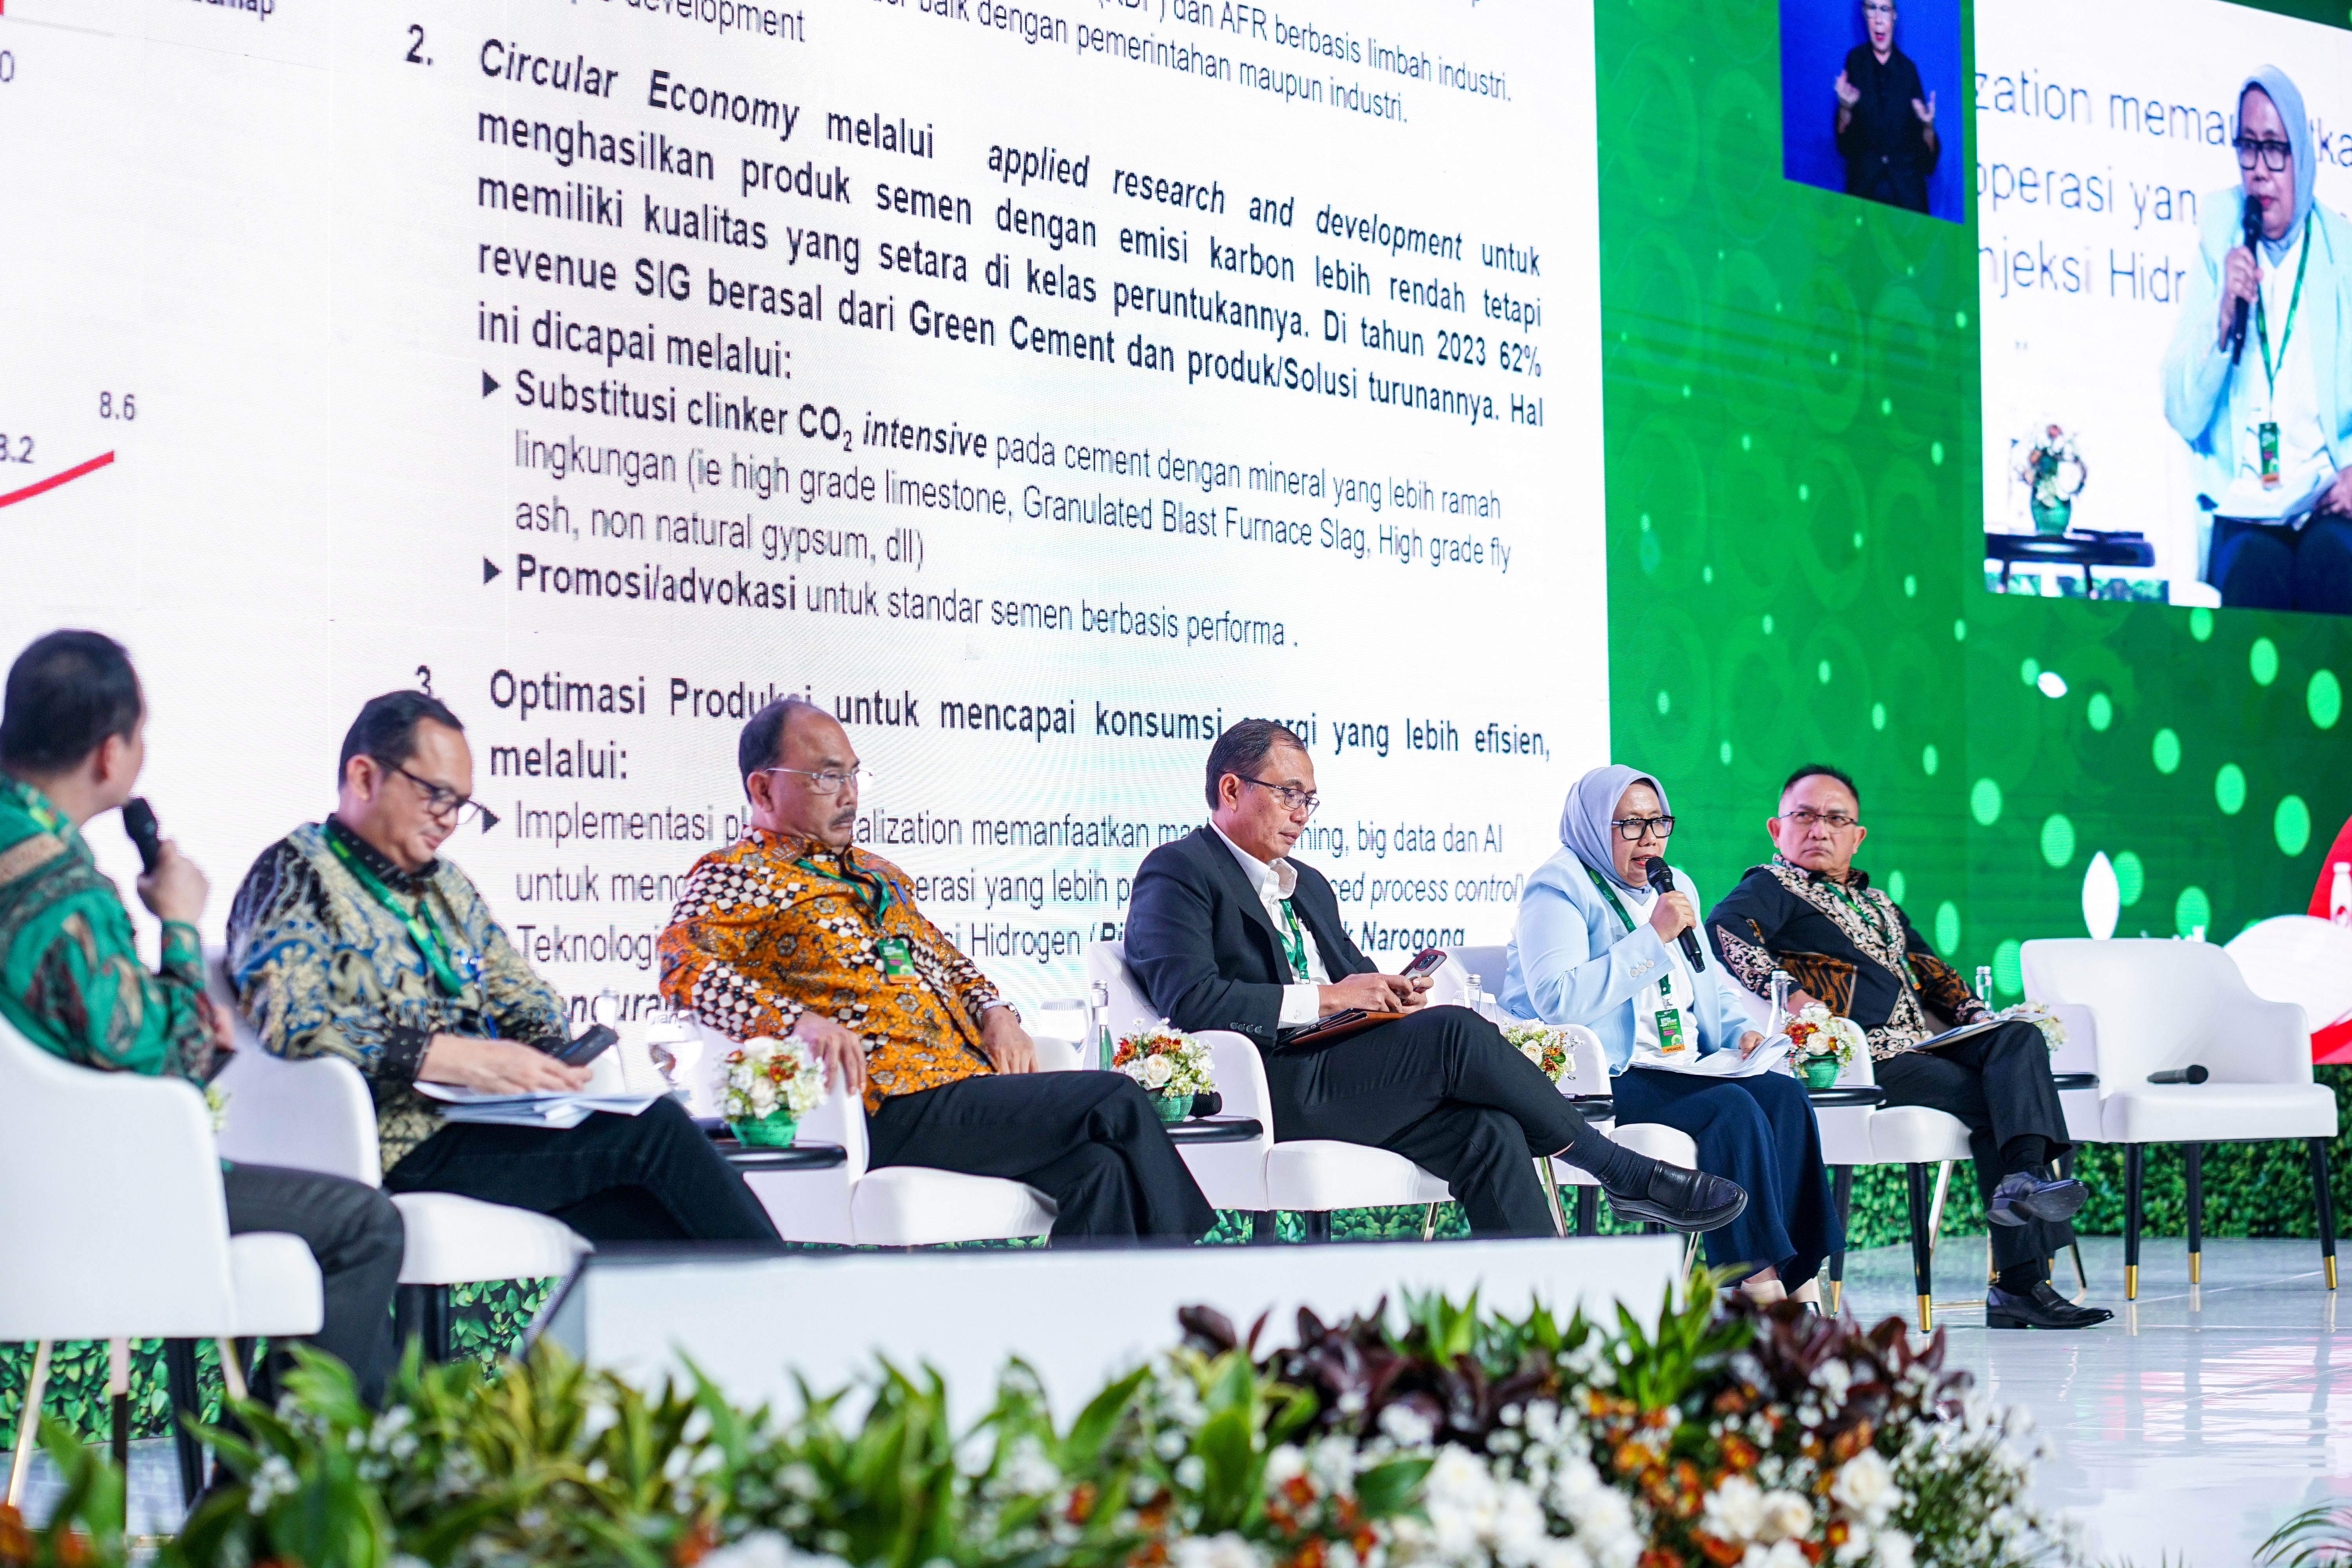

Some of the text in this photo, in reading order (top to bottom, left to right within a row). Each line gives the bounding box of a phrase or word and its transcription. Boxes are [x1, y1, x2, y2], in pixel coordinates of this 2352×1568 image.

[404, 24, 434, 66] 2.
[627, 0, 805, 42] velopment
[978, 0, 1068, 45] dengan
[1076, 23, 1232, 82] pemerintahan
[1240, 61, 1323, 103] maupun
[1330, 76, 1408, 123] industri.
[1220, 0, 1268, 42] AFR
[1275, 13, 1362, 64] berbasis
[1367, 36, 1431, 82] limbah
[1438, 55, 1512, 102] industri.
[479, 37, 1541, 276] Circular Economy melalui applied research and development untuk
[477, 111, 1541, 334] menghasilkan produk semen dengan emisi karbon lebih rendah tetapi
[2130, 181, 2198, 230] yan
[477, 176, 1542, 378] memiliki kualitas yang setara di kelas peruntukannya. Di tahun 2023 62%
[2111, 248, 2186, 304] Hidr
[478, 242, 1544, 426] revenue SIG berasal dari Green Cement dan produk/Solusi turunannya. Hal
[478, 299, 792, 381] ini dicapai melalui:
[99, 391, 136, 421] 8.6
[514, 367, 677, 424] Substitusi
[687, 390, 789, 436] clinker
[862, 411, 989, 460] intensive
[997, 431, 1055, 470] pada
[1065, 443, 1151, 478] cement
[1159, 448, 1240, 492] dengan
[1249, 461, 1325, 499] mineral
[1334, 476, 1382, 512] yang
[1389, 475, 1434, 512] lebih
[1442, 490, 1501, 519] ramah
[515, 429, 1512, 573] lingkungan (ie high grade limestone, Granulated Blast Furnace Slag, High grade fly
[515, 495, 924, 572] ash, non natural gypsum, dll)
[516, 552, 797, 612] Promosi/advokasi
[806, 581, 880, 617] untuk
[887, 586, 984, 625] standar
[991, 596, 1073, 630] semen
[1081, 597, 1179, 639] berbasis
[1185, 610, 1285, 647] performa
[489, 668, 646, 722] Optimasi
[670, 677, 811, 719] Produ
[835, 689, 920, 727] untuk
[939, 699, 1077, 744] mencapai
[1096, 701, 1222, 740] konsumsi
[1332, 721, 1390, 759] yang
[1405, 717, 1459, 752] lebih
[1475, 722, 1550, 763] efisien,
[490, 737, 628, 780] melalui:
[516, 800, 713, 849] Implementasi
[855, 808, 962, 845] alization
[972, 812, 1149, 848] memanfaatkan
[1358, 820, 1387, 858] big
[1394, 821, 1436, 852] data
[1443, 823, 1478, 853] dan
[1484, 824, 1503, 853] AI
[515, 864, 600, 902] untuk
[915, 867, 976, 902] erasi
[984, 875, 1044, 911] yang
[1053, 868, 1108, 902] lebih
[1370, 877, 1449, 909] process
[517, 924, 661, 971] Teknologi
[971, 921, 1081, 964] Hidrogen
[1360, 920, 1466, 957] Narogong
